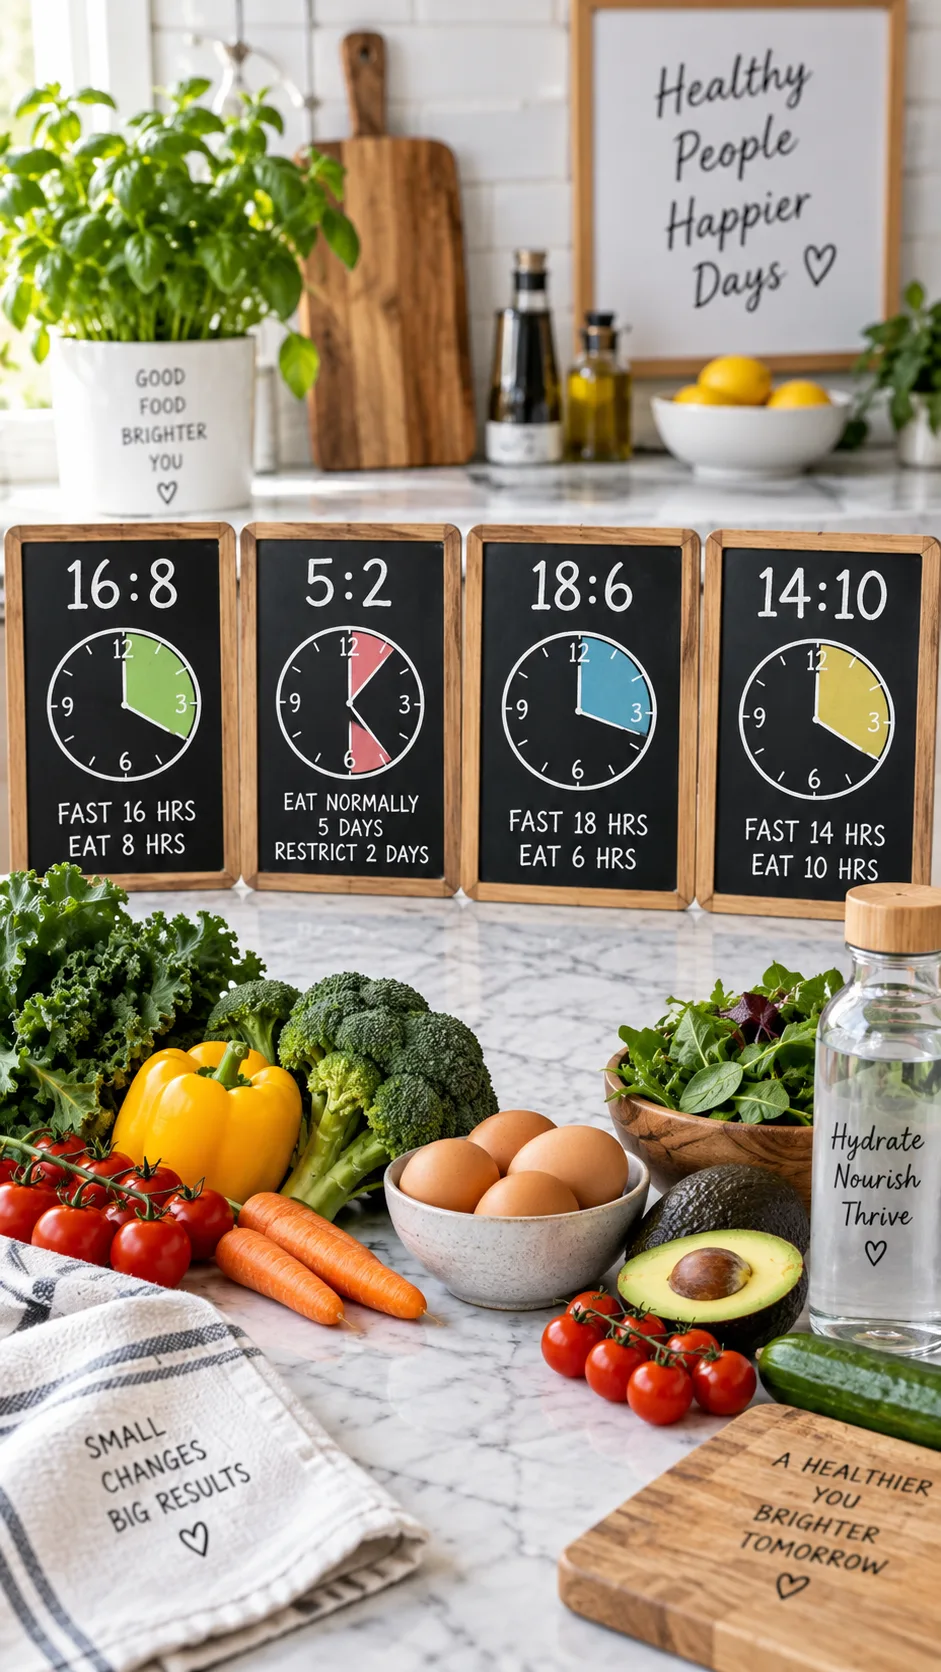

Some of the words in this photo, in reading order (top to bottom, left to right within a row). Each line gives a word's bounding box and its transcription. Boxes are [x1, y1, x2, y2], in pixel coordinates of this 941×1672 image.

[655, 48, 813, 118] Healthy
[673, 114, 799, 181] People
[666, 191, 812, 252] Happier
[693, 261, 788, 312] Days
[136, 368, 185, 388] GOOD
[140, 397, 186, 415] FOOD
[121, 423, 207, 445] BRIGHTER
[150, 454, 183, 471] YOU
[67, 558, 178, 610] 16:8
[305, 558, 392, 607] 5:2
[531, 560, 633, 612] 18:6
[757, 567, 887, 620] 14:10
[113, 639, 134, 659] 12
[340, 637, 359, 657] 12
[569, 643, 590, 663] 12
[807, 650, 828, 671] 12
[61, 697, 74, 717] 9
[175, 694, 187, 713] 3
[289, 693, 300, 712] 9
[399, 695, 410, 714] 3
[516, 699, 529, 719] 9
[630, 703, 642, 722] 3
[753, 707, 766, 728] 9
[868, 712, 880, 732] 3
[119, 751, 132, 771] 6
[344, 750, 356, 769] 6
[571, 759, 584, 780] 6
[808, 769, 821, 789] 6
[58, 801, 112, 825] FAST
[123, 800, 145, 823] 16
[157, 800, 196, 822] HRS
[284, 793, 318, 811] EAT
[326, 793, 419, 813] NORMALLY
[318, 818, 329, 836] 5
[340, 819, 383, 837] DAYS
[509, 810, 563, 832] FAST
[574, 812, 597, 834] 18
[608, 813, 648, 836] HRS
[745, 818, 799, 842] FAST
[810, 821, 834, 844] 14
[845, 823, 886, 846] HRS
[69, 835, 110, 857] EAT
[122, 834, 135, 856] 8
[147, 833, 185, 855] HRS
[275, 842, 357, 862] RESTRICT
[366, 844, 377, 862] 2
[387, 845, 429, 864] DAYS
[520, 845, 561, 867] EAT
[572, 846, 585, 868] 6
[597, 847, 636, 870] HRS
[752, 854, 794, 876] EAT
[805, 856, 827, 879] 10
[839, 858, 878, 881] HRS
[831, 1122, 925, 1161] Hydrate
[834, 1163, 921, 1190] Nourish
[842, 1201, 913, 1226] Thrive
[85, 1417, 166, 1459] SMALL
[101, 1440, 207, 1493] CHANGES
[772, 1452, 791, 1468] A
[801, 1457, 933, 1497] HEALTHIER
[107, 1501, 151, 1533] BIG
[156, 1463, 251, 1514] RESULTS
[813, 1486, 862, 1509] YOU
[753, 1504, 880, 1544] BRIGHTER
[740, 1531, 889, 1575] TOMORROW
